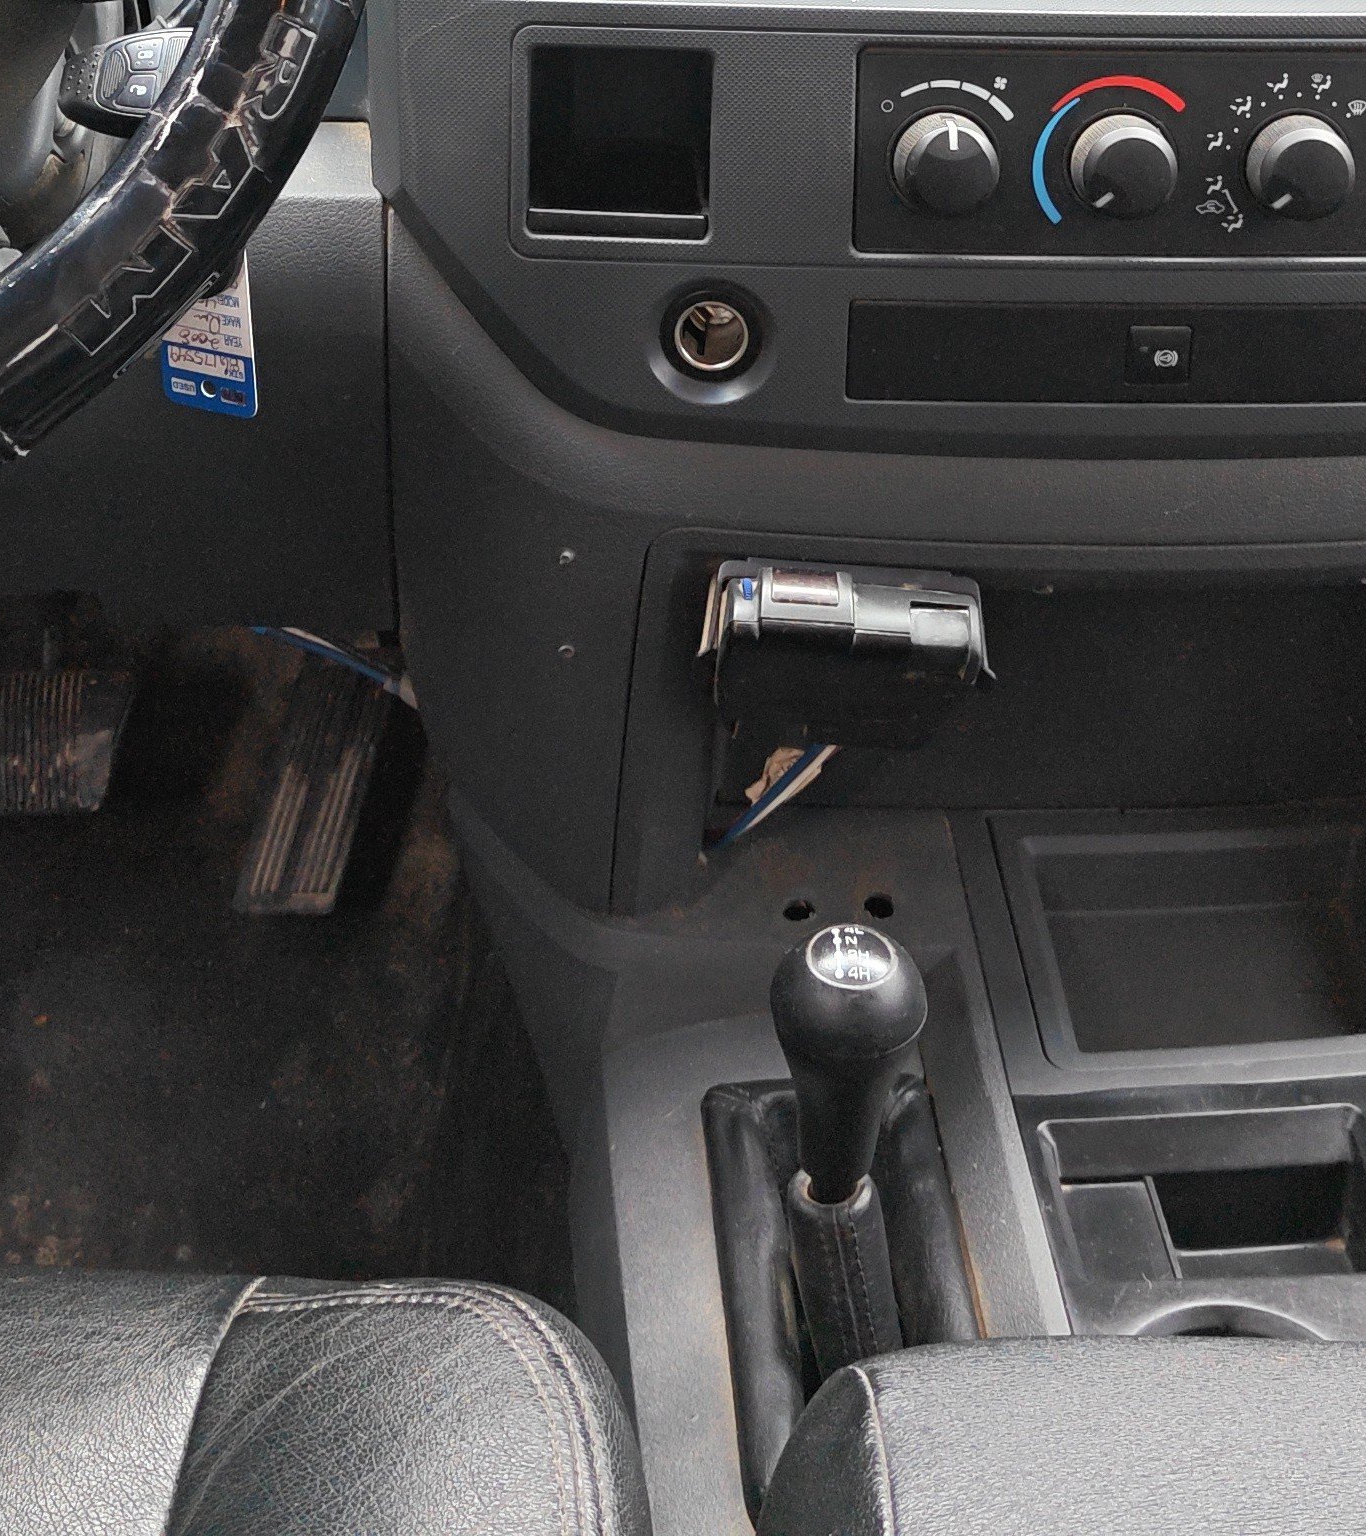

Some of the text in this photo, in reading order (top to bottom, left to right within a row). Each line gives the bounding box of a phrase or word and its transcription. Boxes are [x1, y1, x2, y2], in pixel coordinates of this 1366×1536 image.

[222, 314, 241, 329] MAKE
[224, 334, 243, 348] YEAR
[172, 380, 195, 392] USED
[843, 926, 865, 935] 4L
[845, 935, 858, 945] N
[847, 966, 871, 982] 4H
